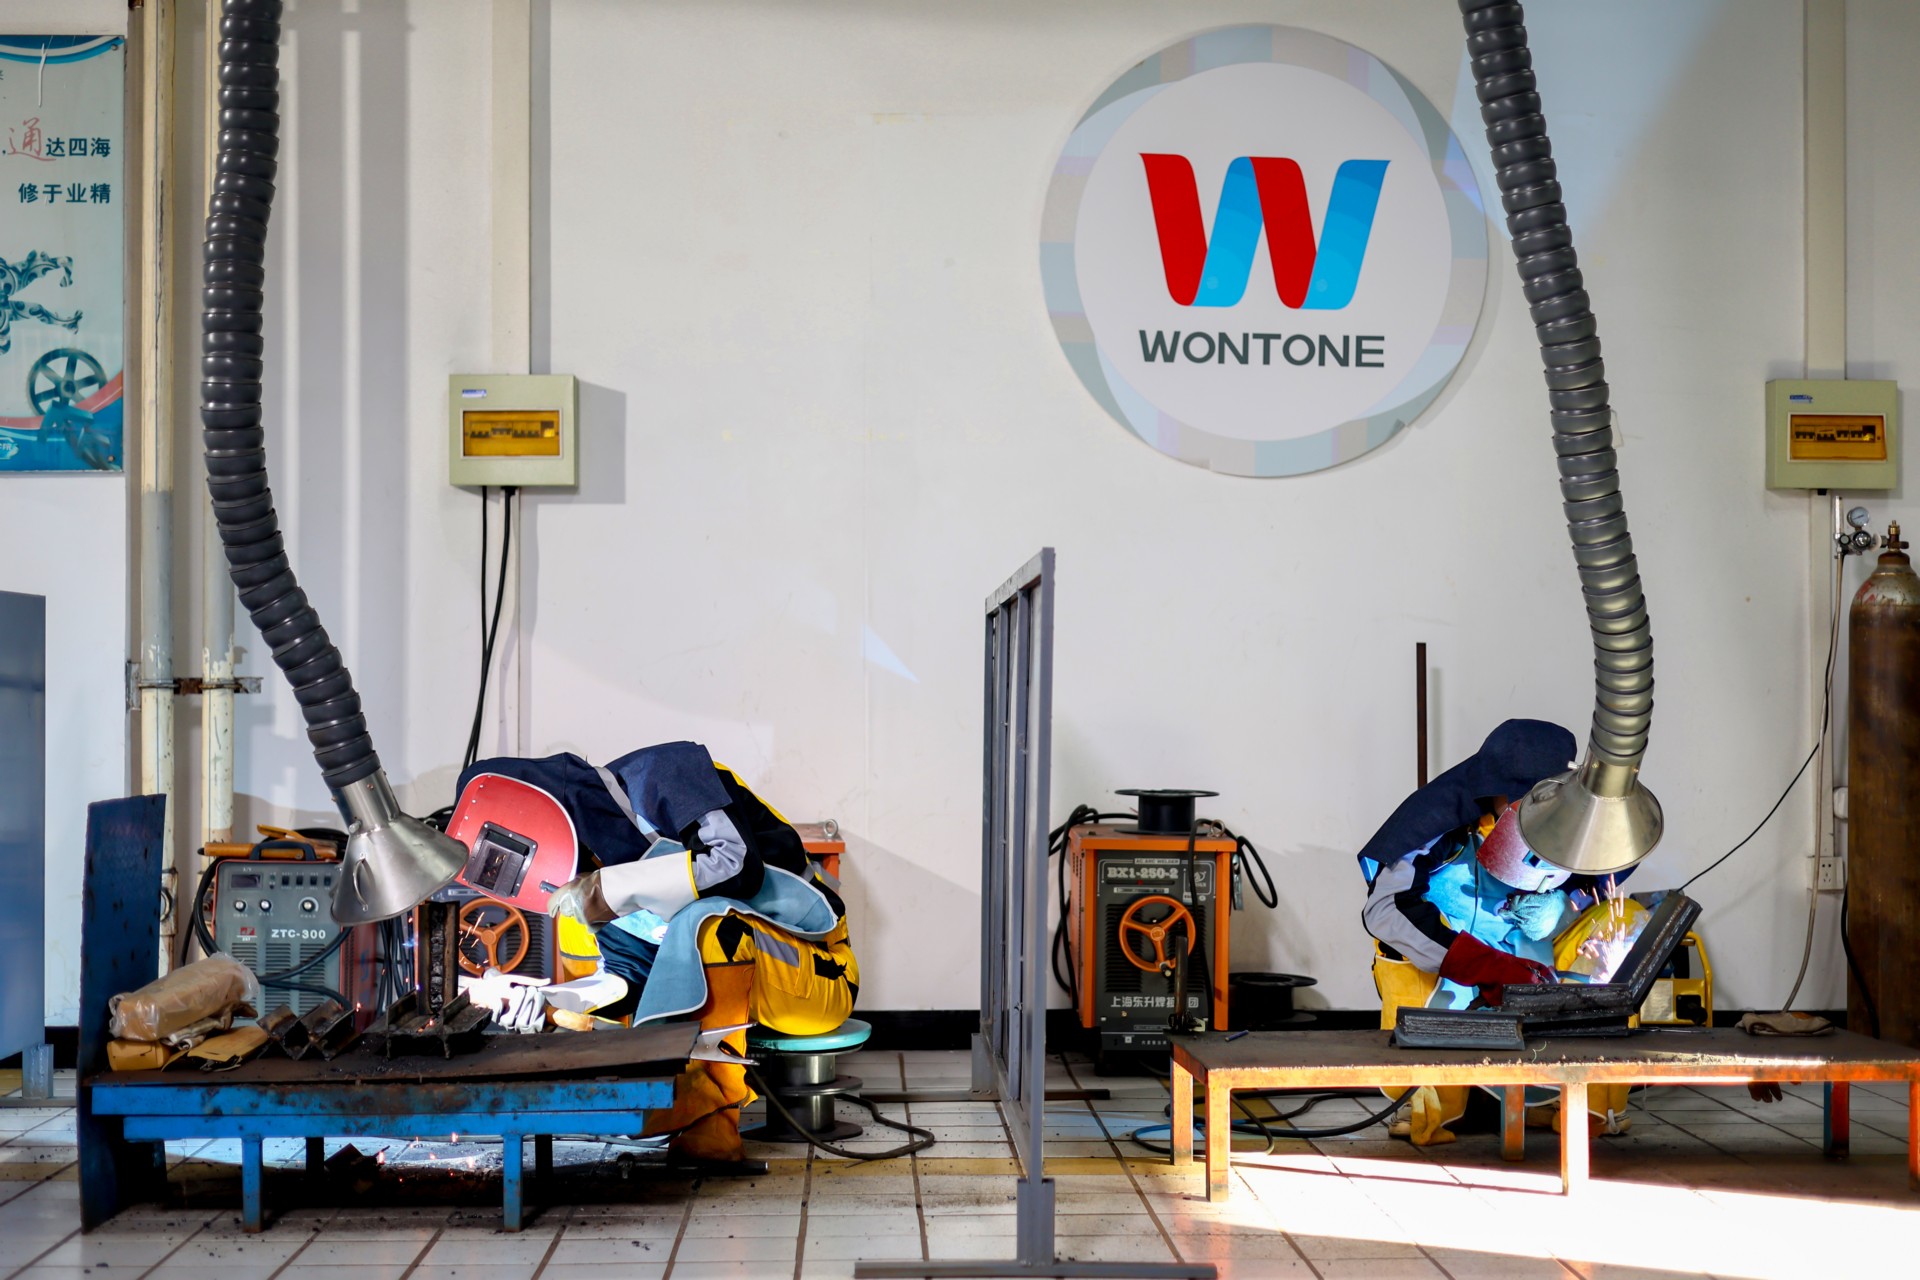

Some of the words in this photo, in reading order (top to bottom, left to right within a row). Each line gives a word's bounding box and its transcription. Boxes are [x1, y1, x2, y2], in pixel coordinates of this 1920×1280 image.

[18, 183, 111, 204] 修于业精
[1139, 329, 1385, 368] WONTONE
[1107, 867, 1179, 879] BX1-250-2
[271, 929, 326, 939] ZTC-300
